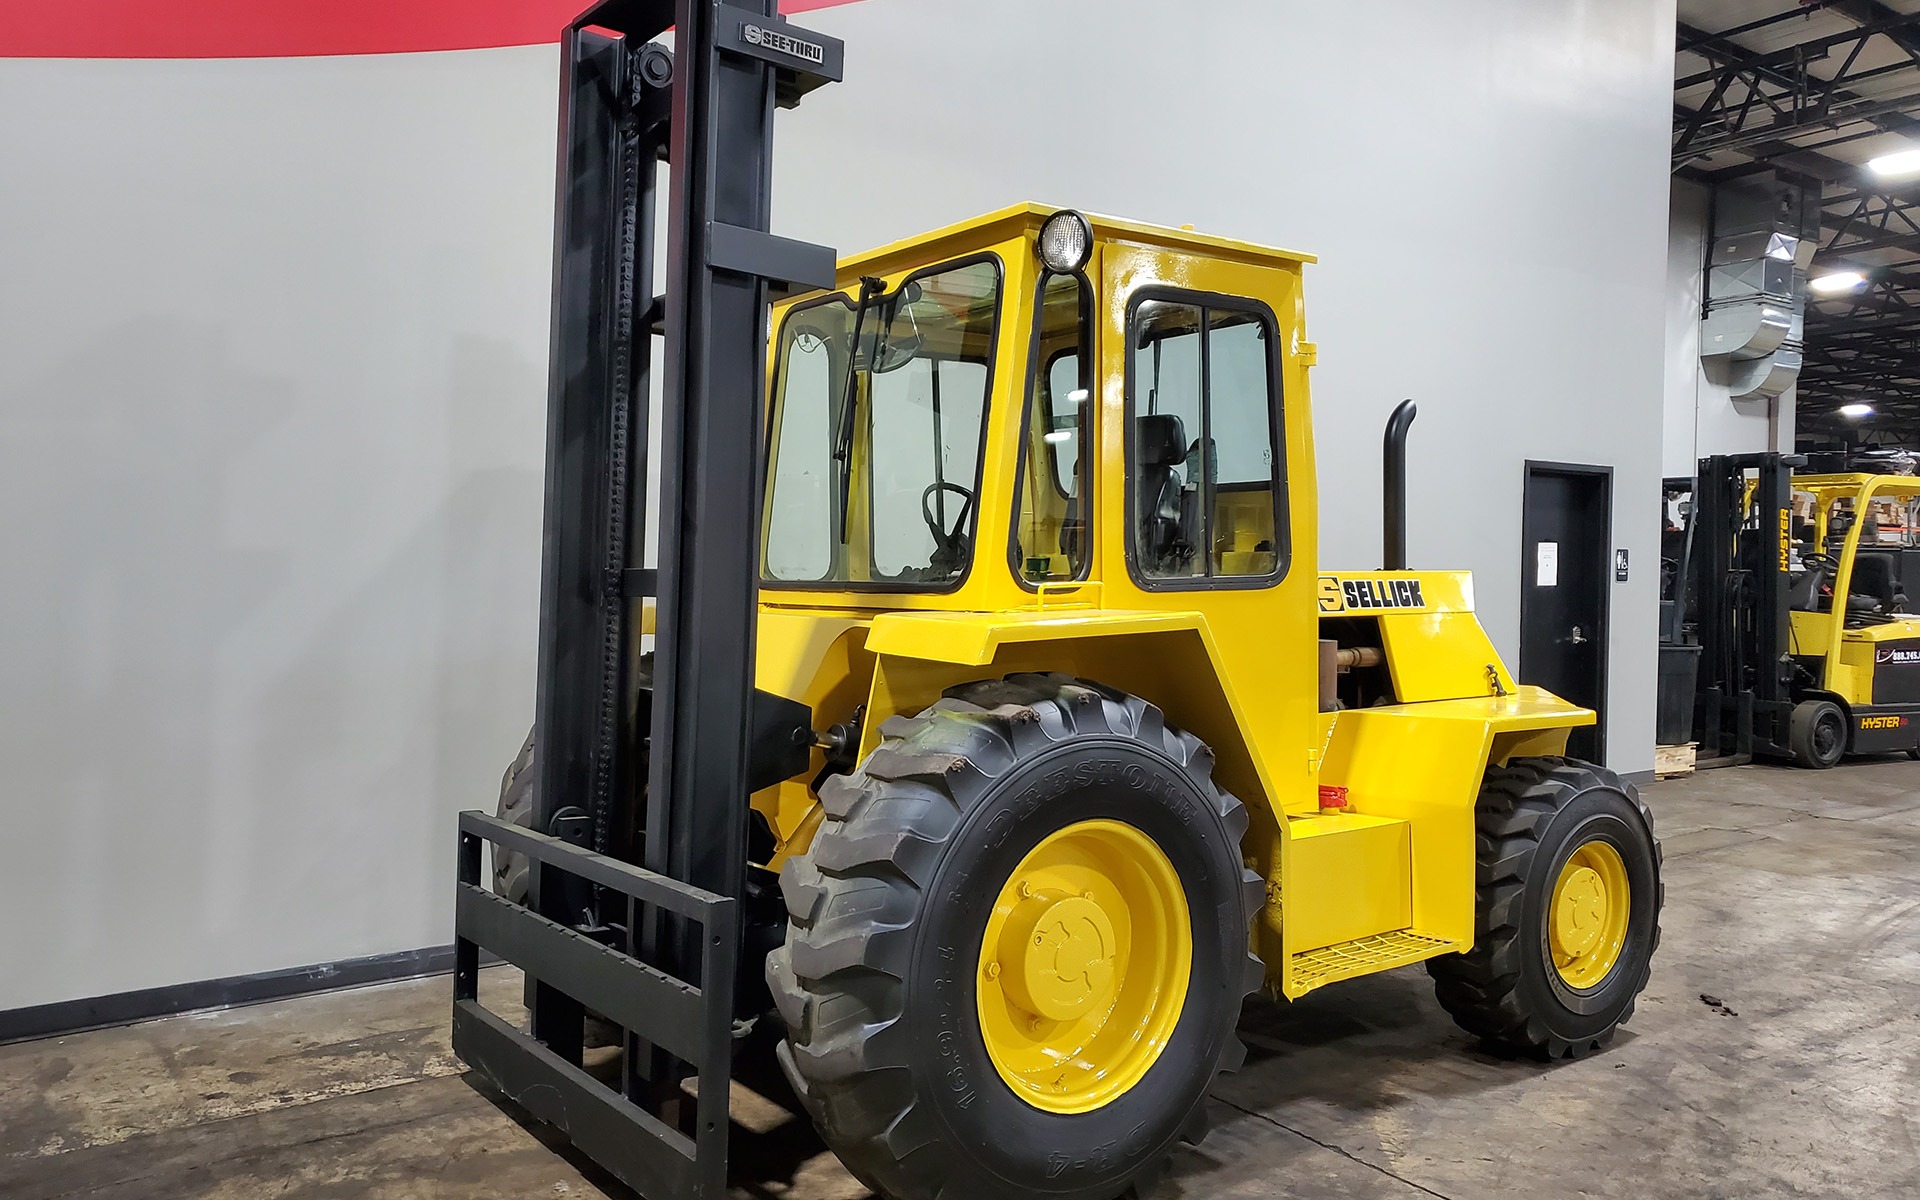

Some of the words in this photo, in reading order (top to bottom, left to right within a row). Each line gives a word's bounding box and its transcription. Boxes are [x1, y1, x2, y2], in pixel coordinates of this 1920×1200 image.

[763, 31, 821, 60] SEE-THRU
[1779, 508, 1789, 572] HYSTER
[1343, 580, 1426, 608] SELLICK
[1861, 716, 1900, 729] HYSTER
